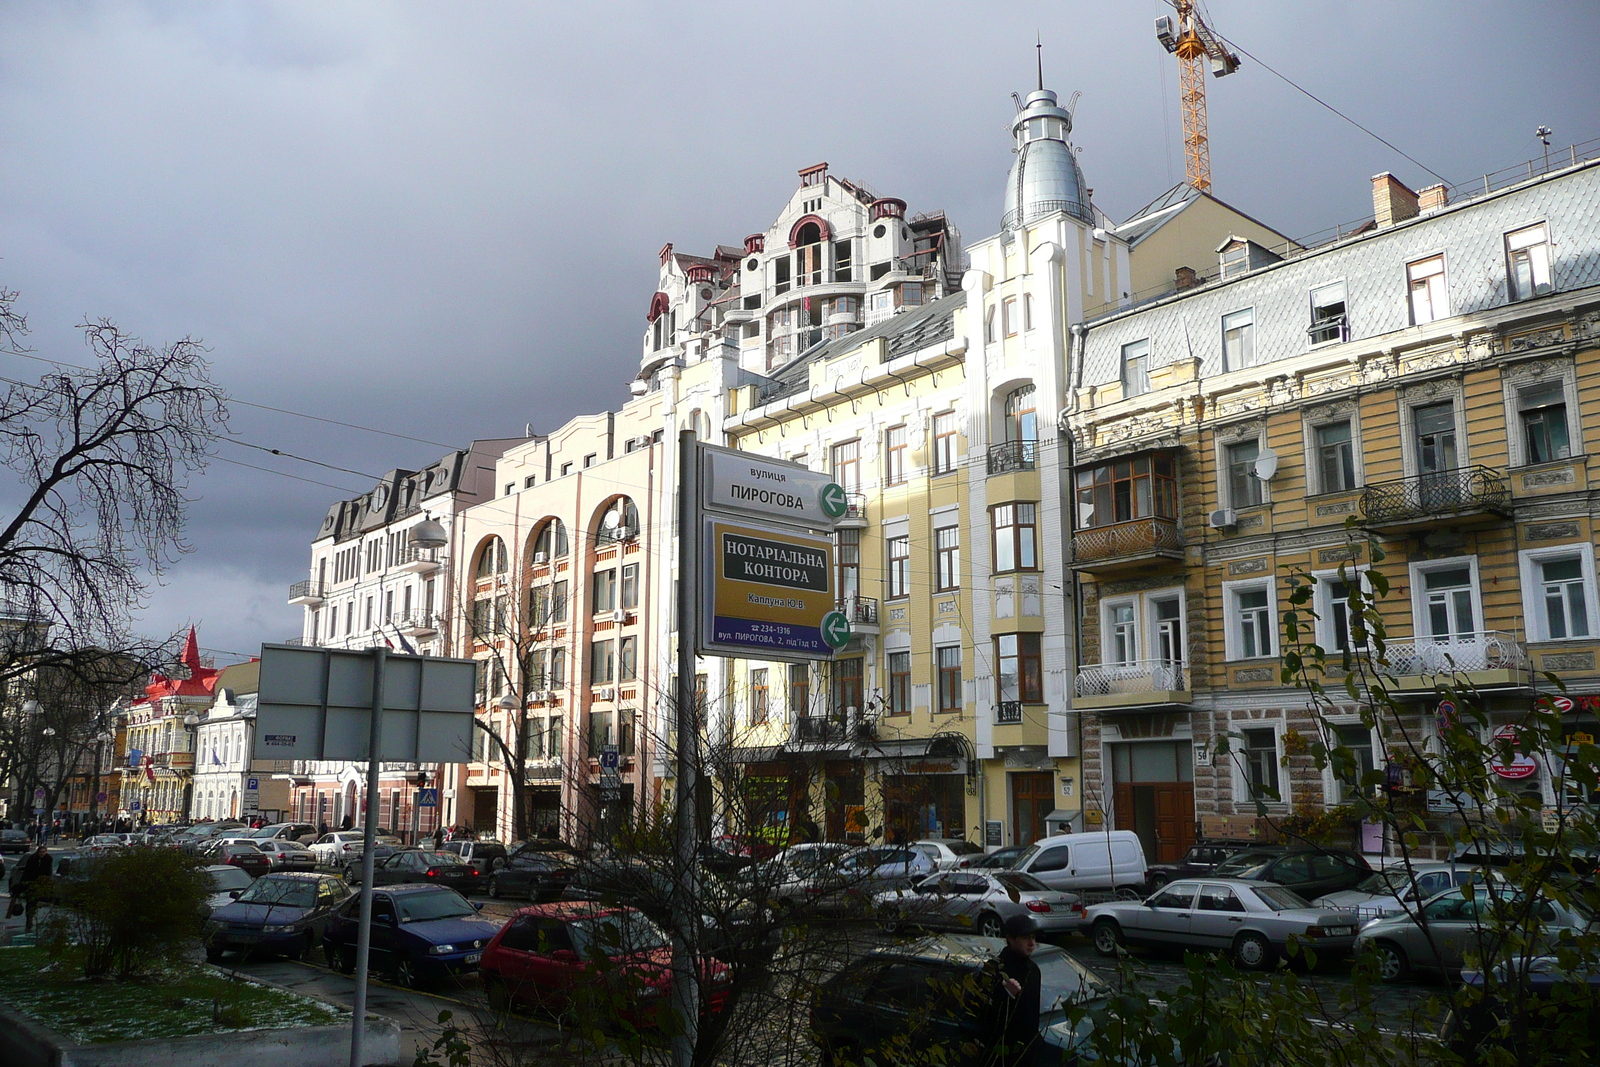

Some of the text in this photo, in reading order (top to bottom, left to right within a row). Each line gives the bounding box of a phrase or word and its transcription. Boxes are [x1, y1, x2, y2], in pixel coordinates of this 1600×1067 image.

[750, 468, 786, 482] вулиця
[731, 484, 804, 510] ПИРОГОВА
[726, 540, 825, 568] НОТАРІАЛЬНА
[744, 561, 810, 583] КОНТОРА
[748, 593, 806, 610] Каплуна Ю.В.
[760, 624, 791, 635] 234-1316
[718, 632, 732, 641] вул.
[735, 632, 776, 644] ПИРОГОВА,
[811, 640, 818, 648] 12
[1063, 786, 1071, 795] 52
